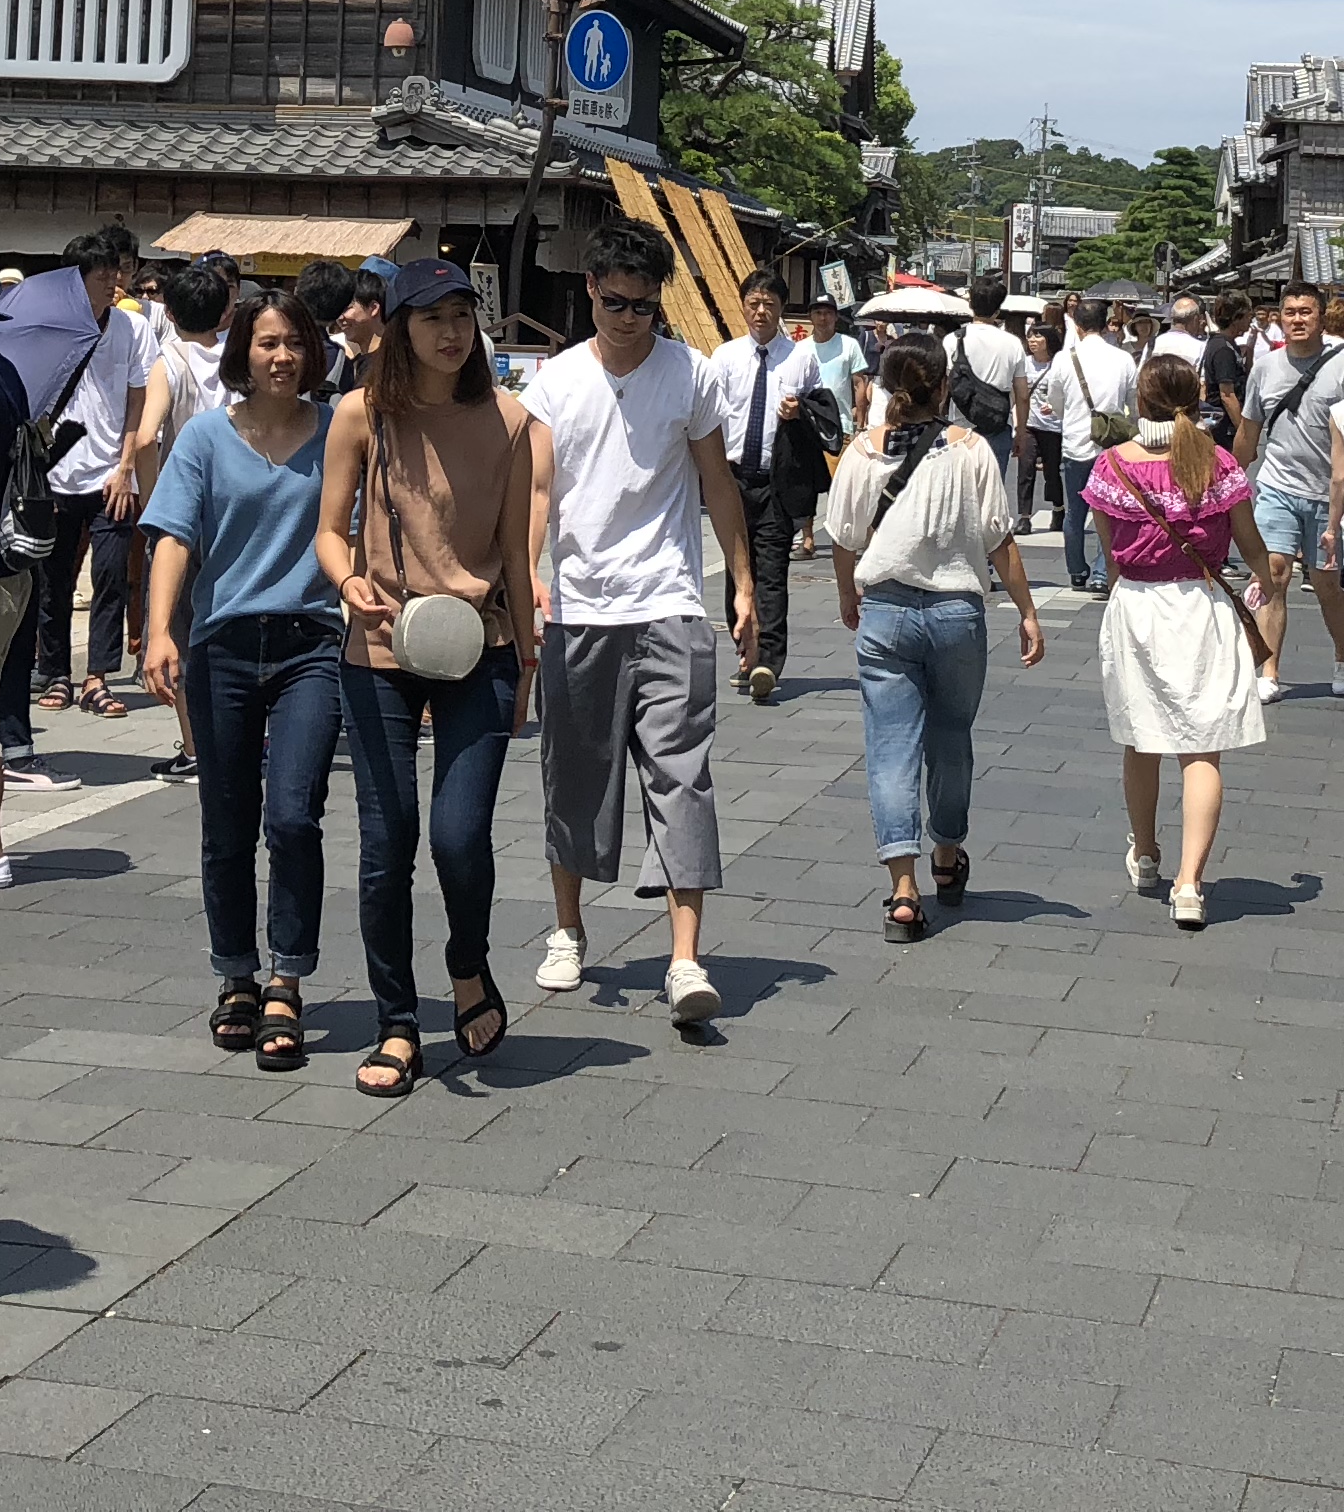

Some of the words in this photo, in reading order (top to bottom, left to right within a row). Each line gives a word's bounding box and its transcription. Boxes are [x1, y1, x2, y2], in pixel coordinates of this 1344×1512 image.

[573, 98, 619, 120] 自転車を除く
